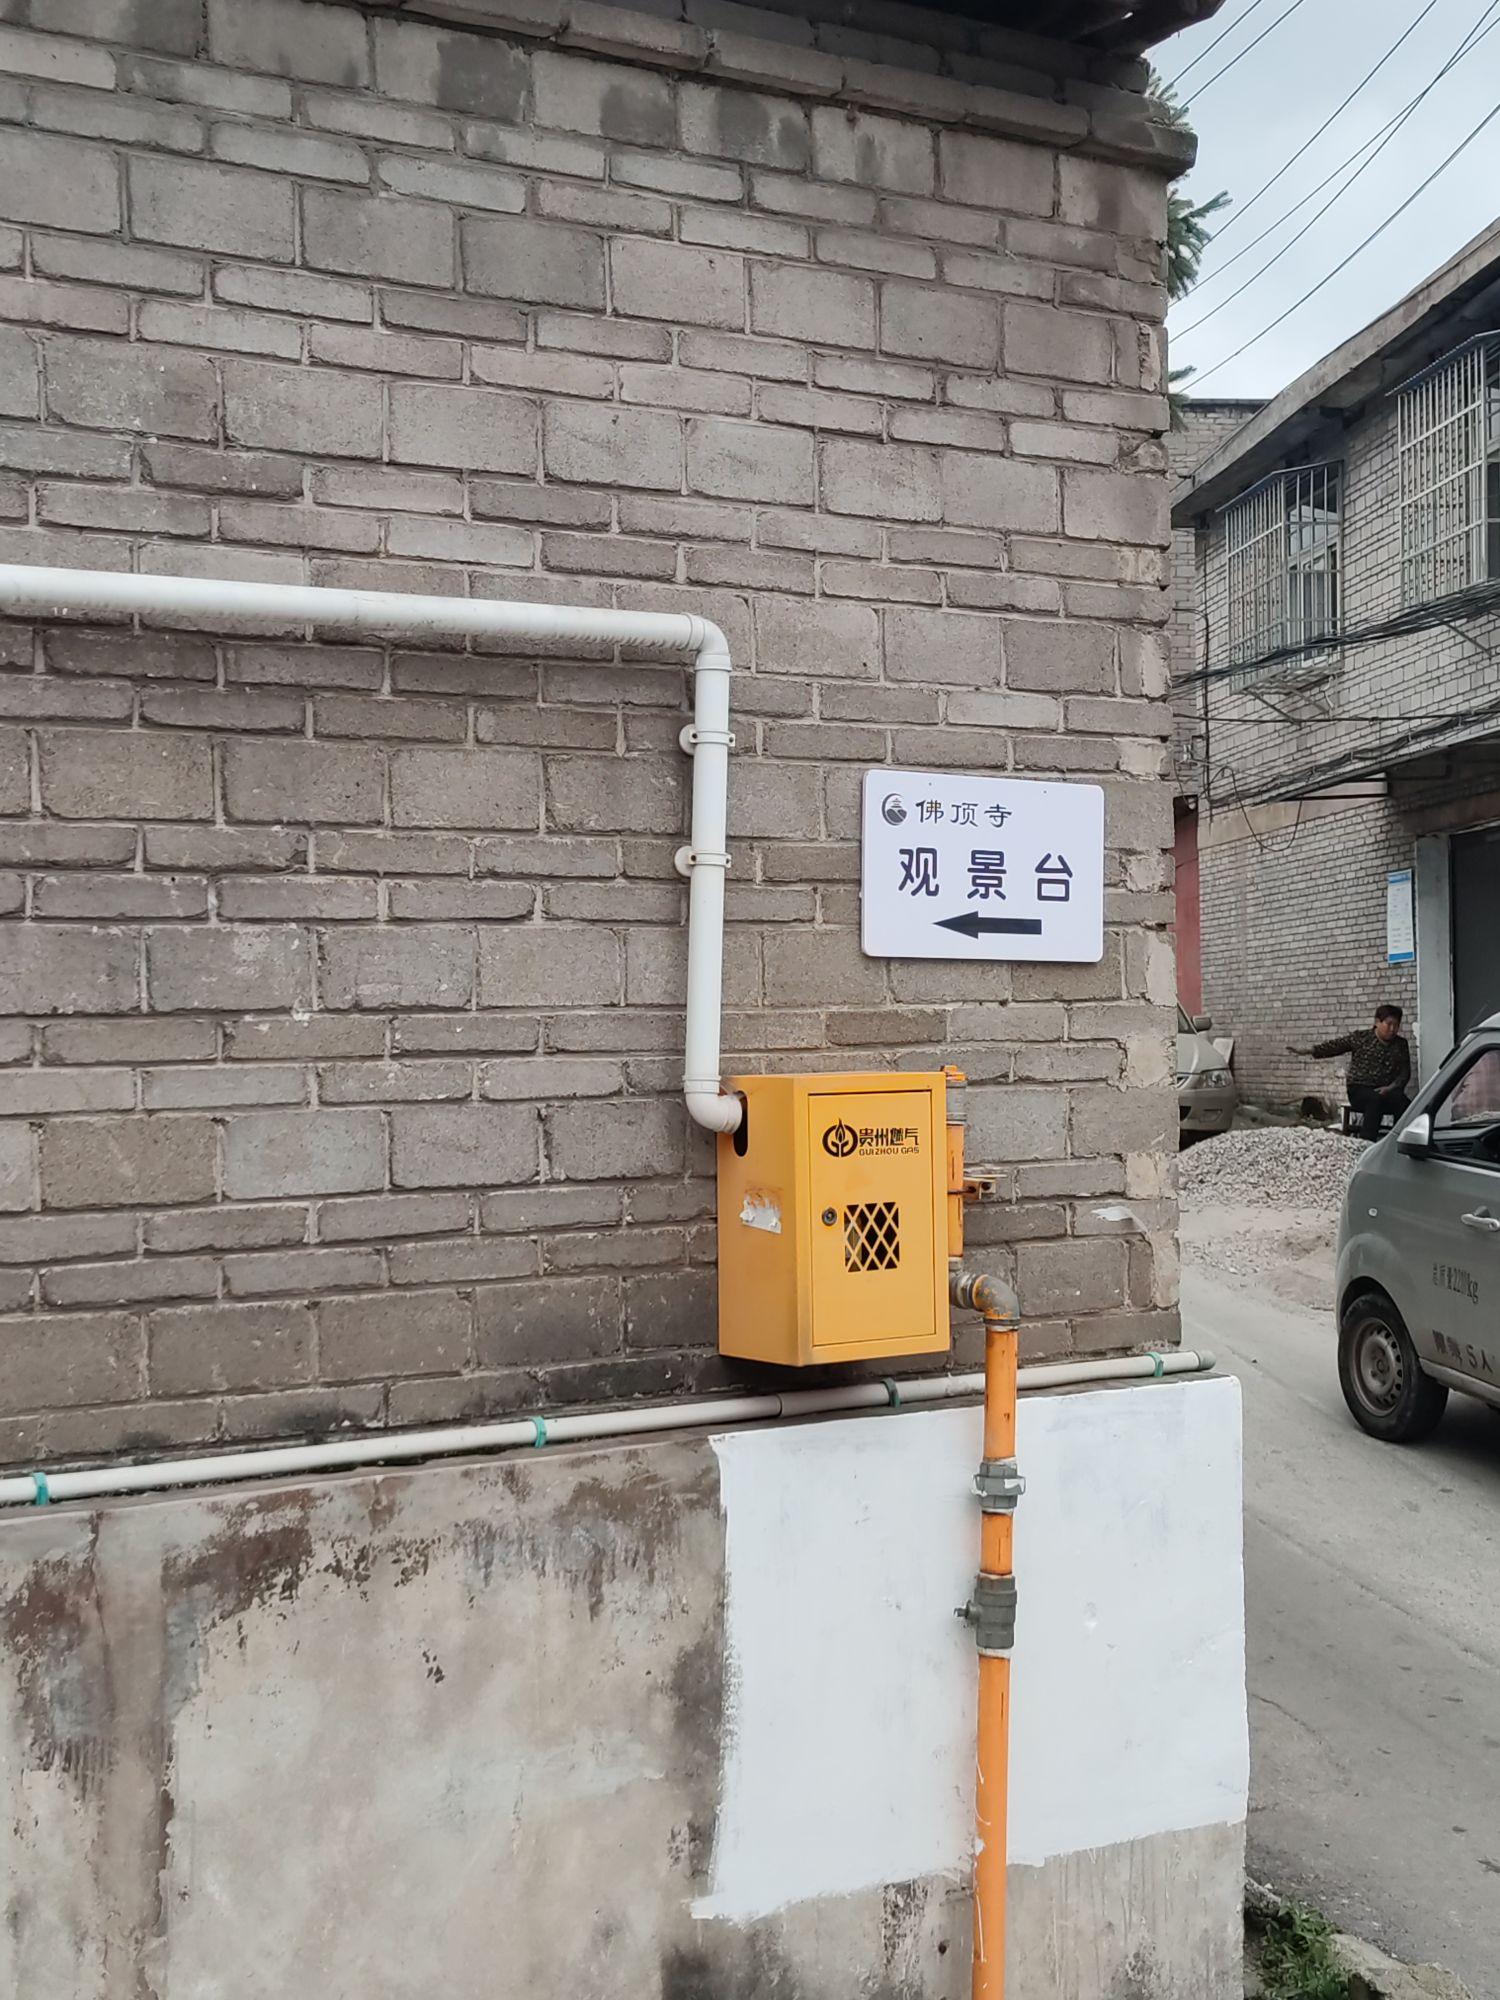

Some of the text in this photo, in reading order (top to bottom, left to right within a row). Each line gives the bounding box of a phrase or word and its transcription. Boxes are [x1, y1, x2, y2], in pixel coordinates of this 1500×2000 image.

[915, 799, 1013, 828] 佛顶寺
[897, 846, 1074, 903] 观景台
[859, 1127, 919, 1147] 贵州燃气
[859, 1146, 920, 1156] GUIZHOU GAS
